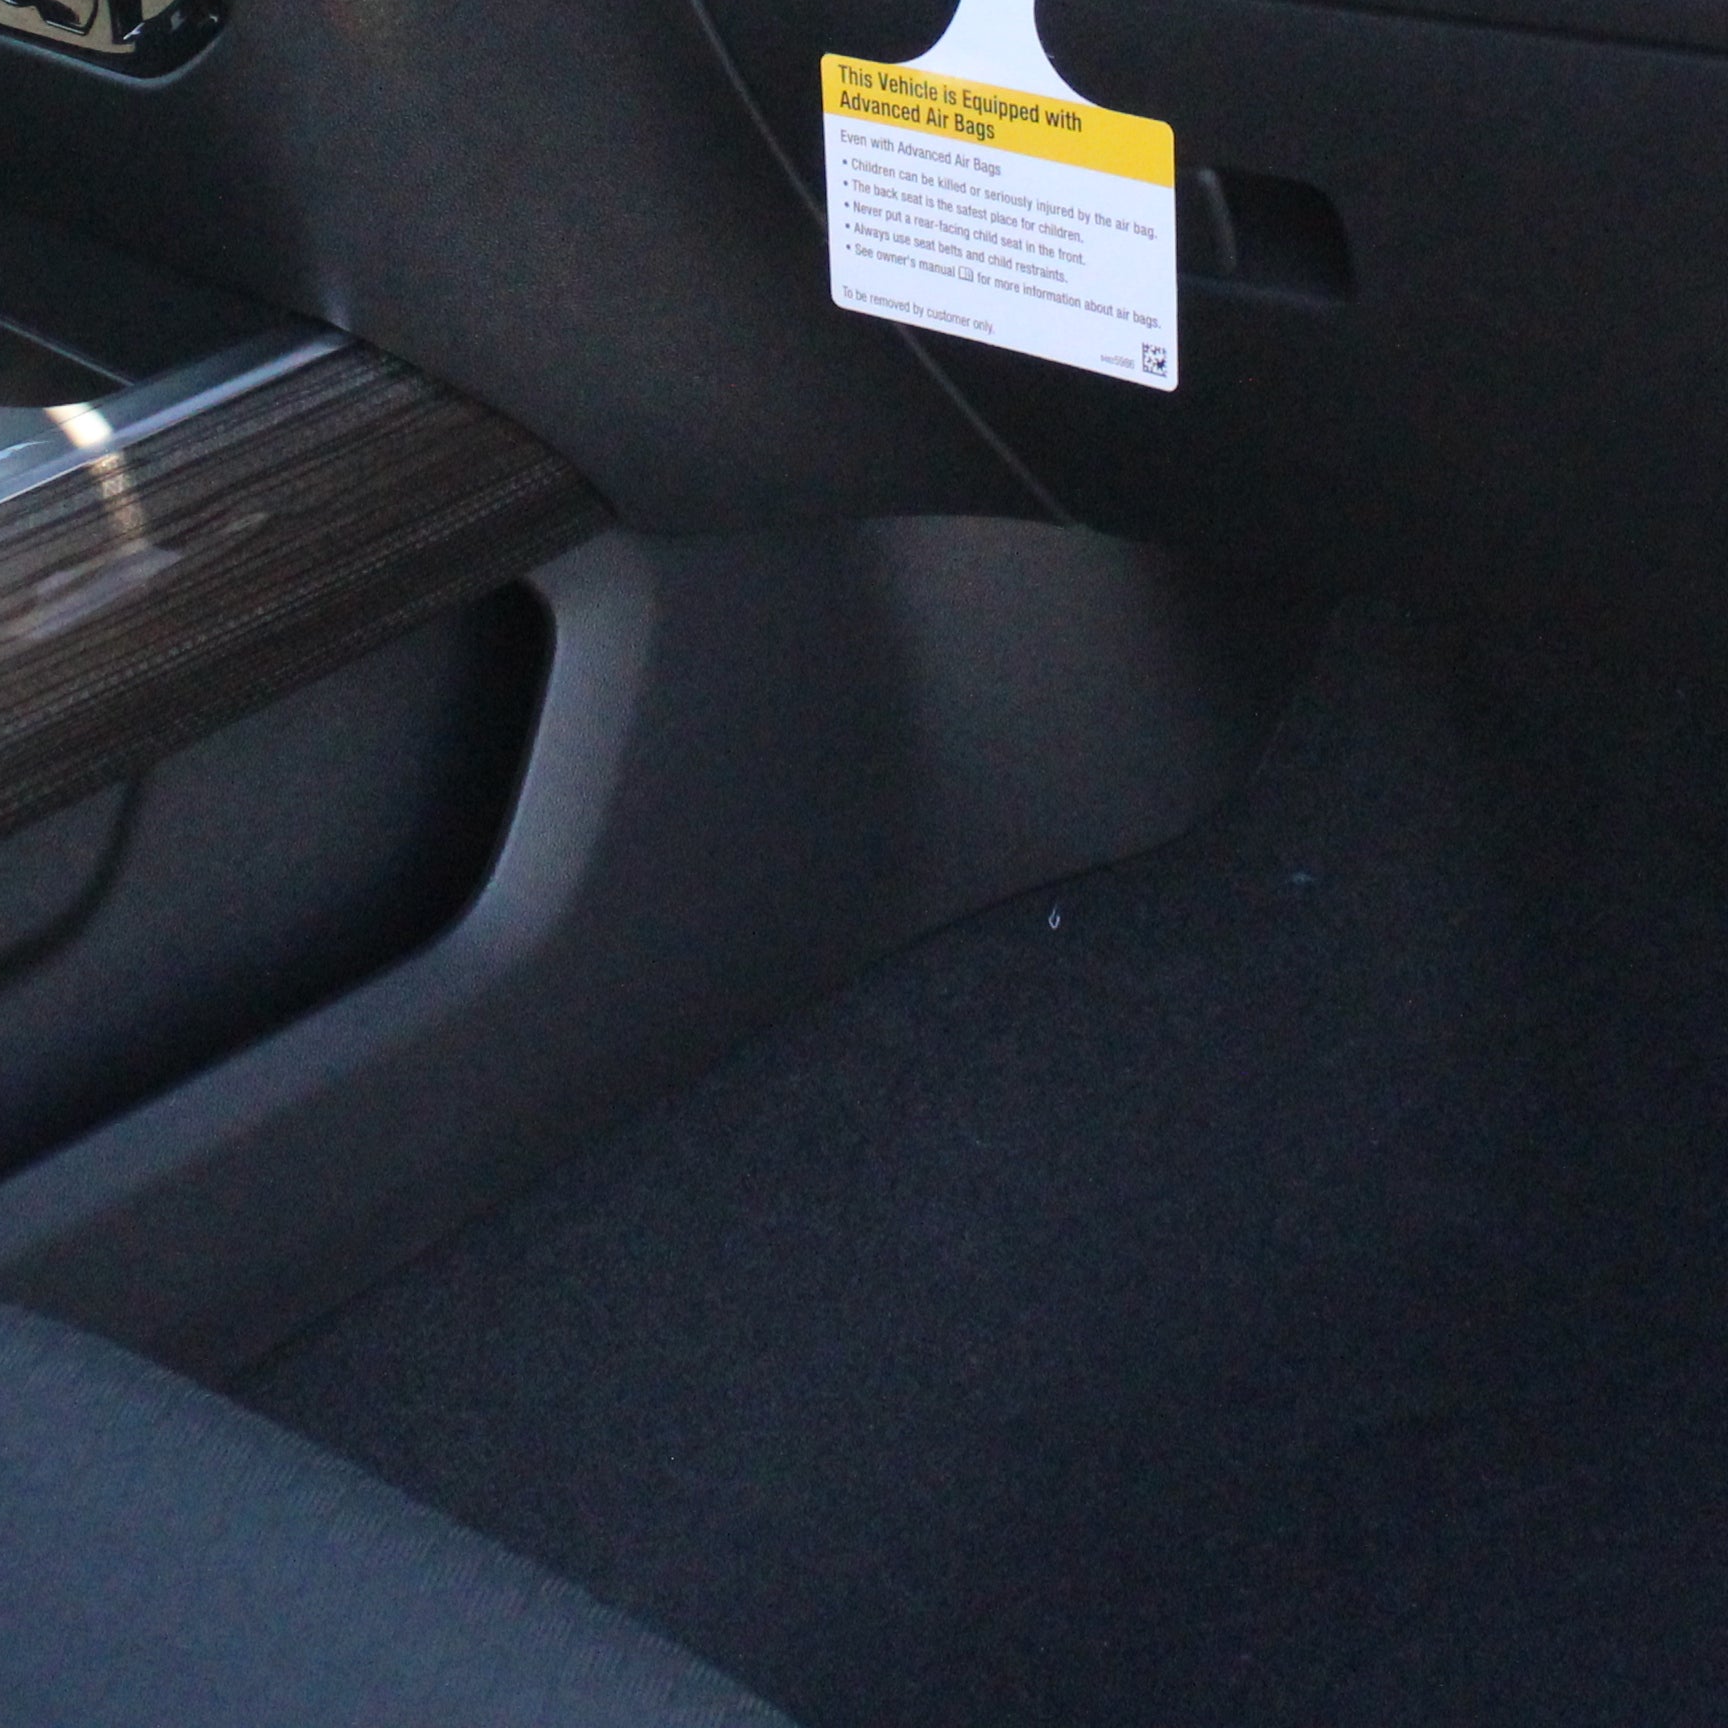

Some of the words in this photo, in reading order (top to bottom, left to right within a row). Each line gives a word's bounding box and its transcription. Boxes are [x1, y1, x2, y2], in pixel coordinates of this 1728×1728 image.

[838, 65, 872, 88] This
[878, 72, 938, 101] Vehicle
[944, 85, 956, 105] is
[962, 89, 1039, 123] Equipped
[1045, 109, 1082, 132] with
[840, 90, 920, 123] Advanced
[926, 107, 949, 129] Air
[954, 113, 995, 142] Bags
[840, 129, 867, 147] Even
[870, 136, 894, 152] with
[897, 141, 951, 165] Advanced
[955, 153, 969, 169] Air
[973, 157, 1002, 178] Bags
[851, 158, 895, 178] Children
[899, 170, 918, 183] can
[922, 172, 934, 187] be
[937, 176, 966, 194] killed
[970, 185, 980, 196] or
[984, 187, 1033, 211] seriously
[1036, 198, 1074, 218] injured
[1078, 207, 1091, 225] by
[1094, 213, 1112, 228] the
[1115, 218, 1130, 231] air
[1133, 221, 1158, 240] bag.
[852, 179, 870, 194] The
[874, 183, 898, 200] back
[901, 190, 923, 205] seat
[925, 194, 934, 209] is
[937, 196, 953, 212] the
[956, 202, 987, 221] safest
[990, 212, 1017, 227] place
[1021, 217, 1035, 231] for
[1038, 222, 1084, 243] children.
[853, 200, 882, 216] Never
[885, 208, 902, 222] put
[905, 214, 911, 224] a
[914, 216, 970, 240] rear-facing
[973, 229, 998, 245] child
[1001, 235, 1022, 250] seat
[1026, 240, 1035, 254] in
[1038, 243, 1055, 258] the
[1058, 248, 1086, 265] front.
[854, 222, 890, 241] Always
[893, 233, 911, 245] use
[914, 236, 935, 251] seat
[938, 241, 963, 258] belts
[966, 248, 985, 263] and
[988, 253, 1013, 270] child
[1015, 260, 1068, 283] restraints.
[842, 285, 853, 299] To
[856, 289, 867, 302] be
[870, 293, 910, 312] removed
[913, 300, 924, 317] by
[927, 308, 970, 327] customer
[973, 318, 995, 335] only.
[855, 243, 873, 258] See
[876, 251, 916, 268] owner's
[919, 260, 955, 278] manual
[977, 272, 991, 286] for
[994, 278, 1020, 293] more
[1023, 283, 1081, 308] information
[1084, 299, 1114, 317] about
[1116, 308, 1130, 322] air
[1133, 310, 1161, 329] bags.
